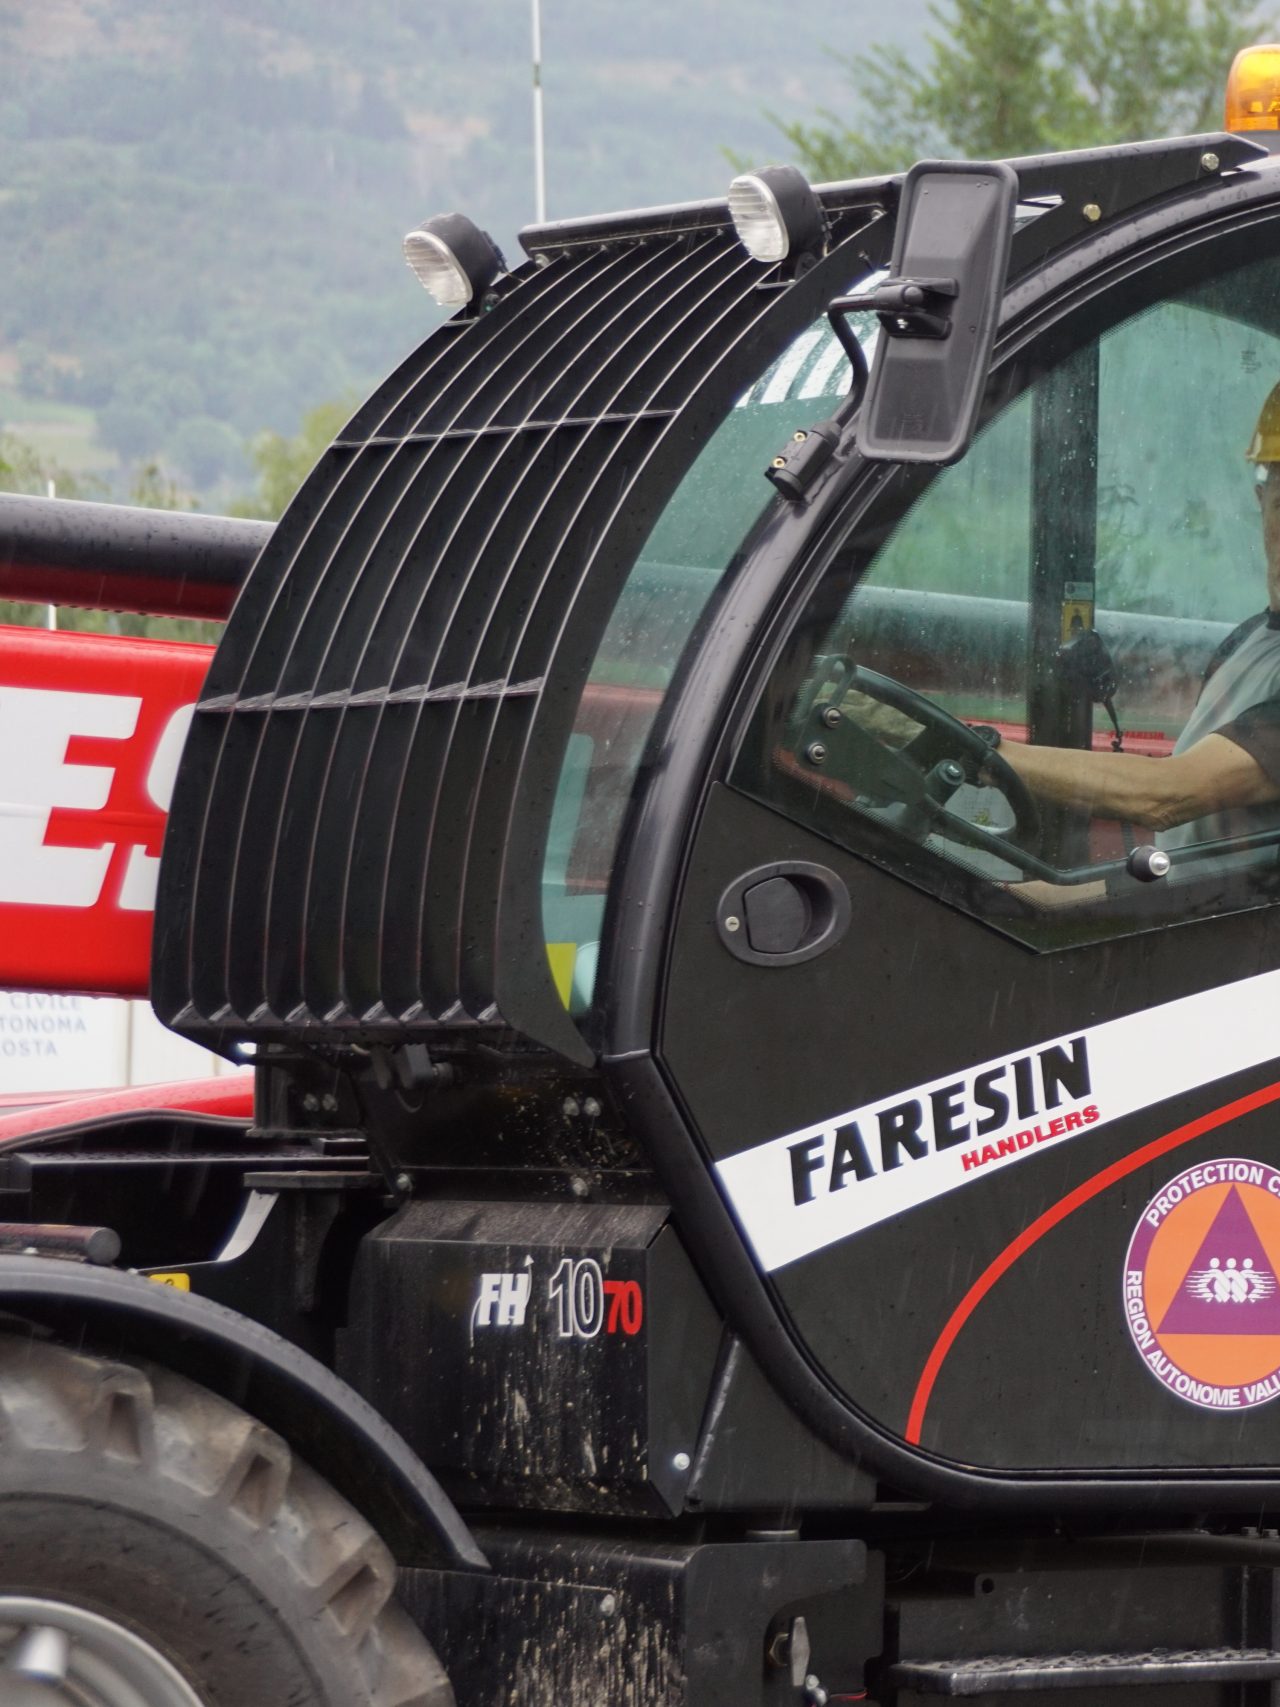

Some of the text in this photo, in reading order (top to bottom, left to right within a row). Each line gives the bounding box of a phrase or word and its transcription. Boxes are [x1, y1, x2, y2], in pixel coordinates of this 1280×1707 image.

[787, 1036, 1092, 1206] FARESIN
[961, 1105, 1100, 1172] HANDLERS
[1146, 1163, 1264, 1228] PROTECTION
[476, 1273, 529, 1326] FH
[1126, 1269, 1156, 1350] REGION
[1147, 1350, 1240, 1406] AUTONOME
